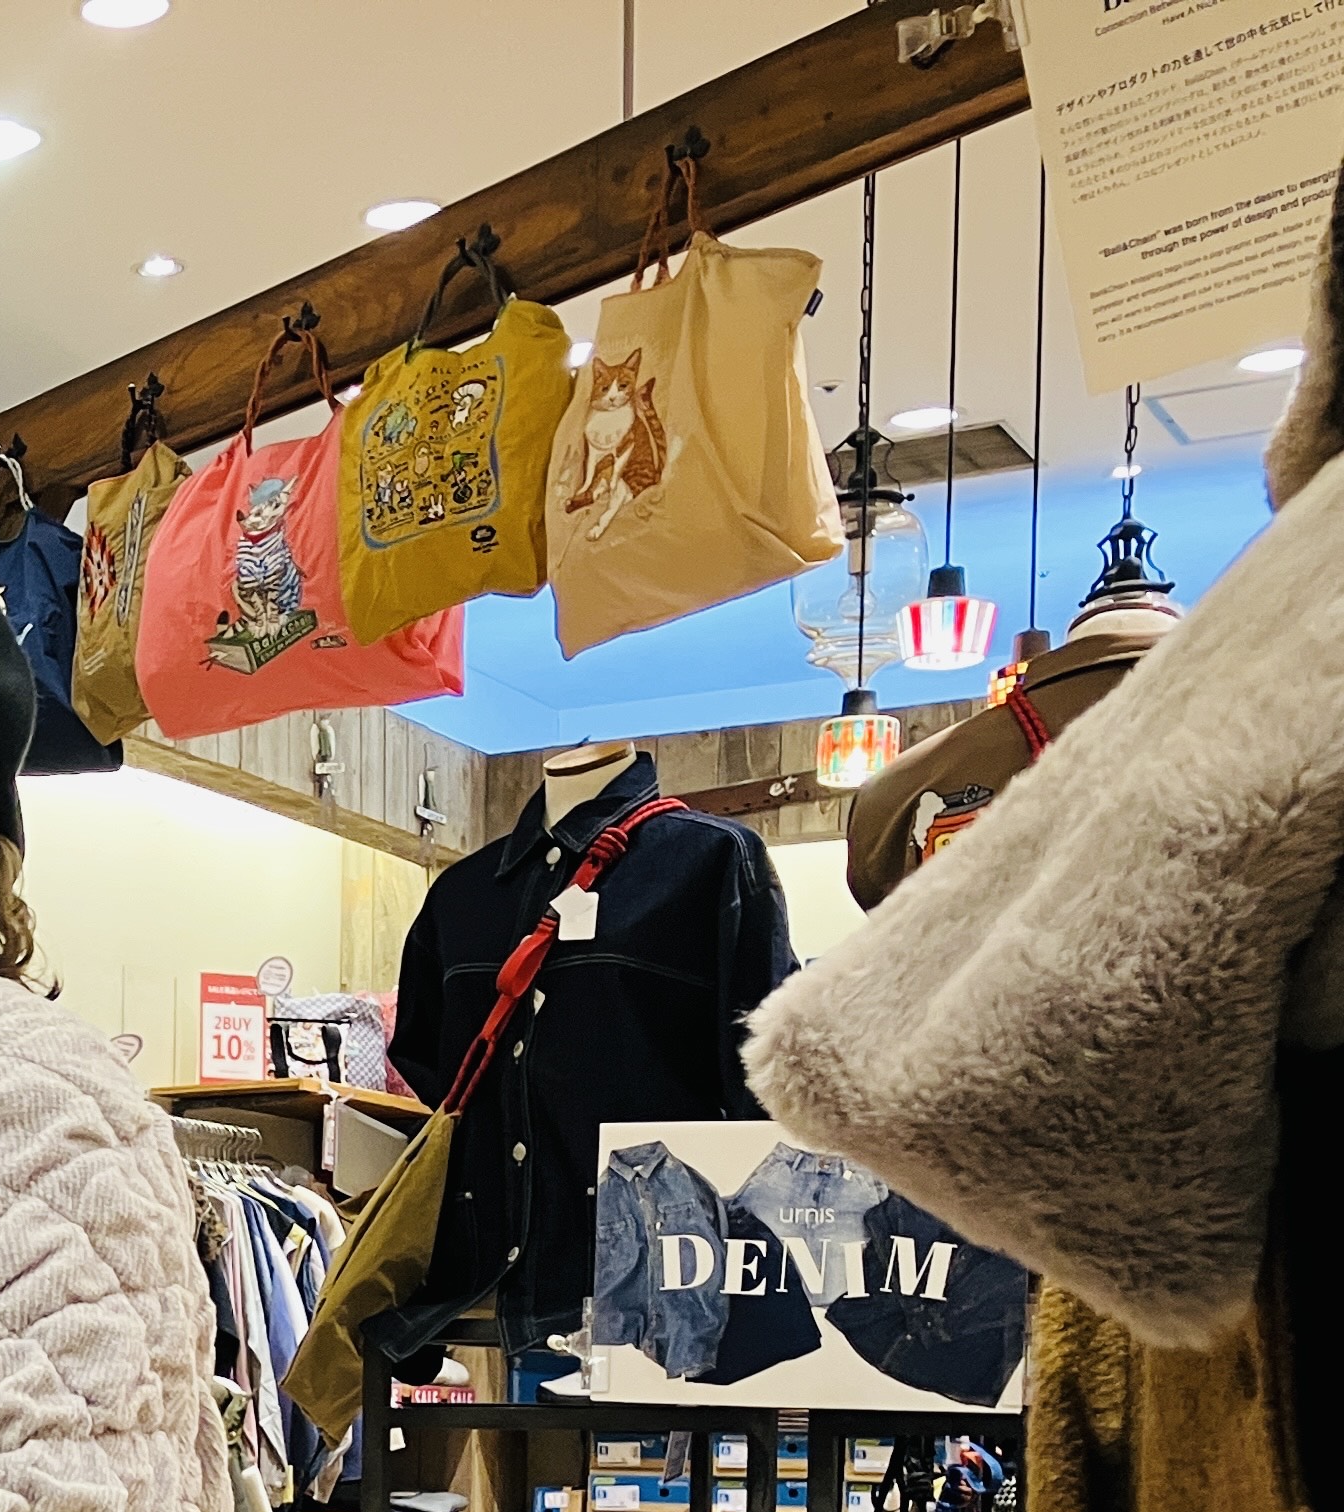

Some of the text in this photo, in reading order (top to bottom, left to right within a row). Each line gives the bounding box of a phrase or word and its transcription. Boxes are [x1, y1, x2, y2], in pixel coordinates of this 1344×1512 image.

[1141, 241, 1180, 260] through
[1199, 223, 1229, 242] power
[1244, 206, 1278, 224] design
[214, 1015, 253, 1031] 2BUY
[657, 1233, 958, 1302] DENIM
